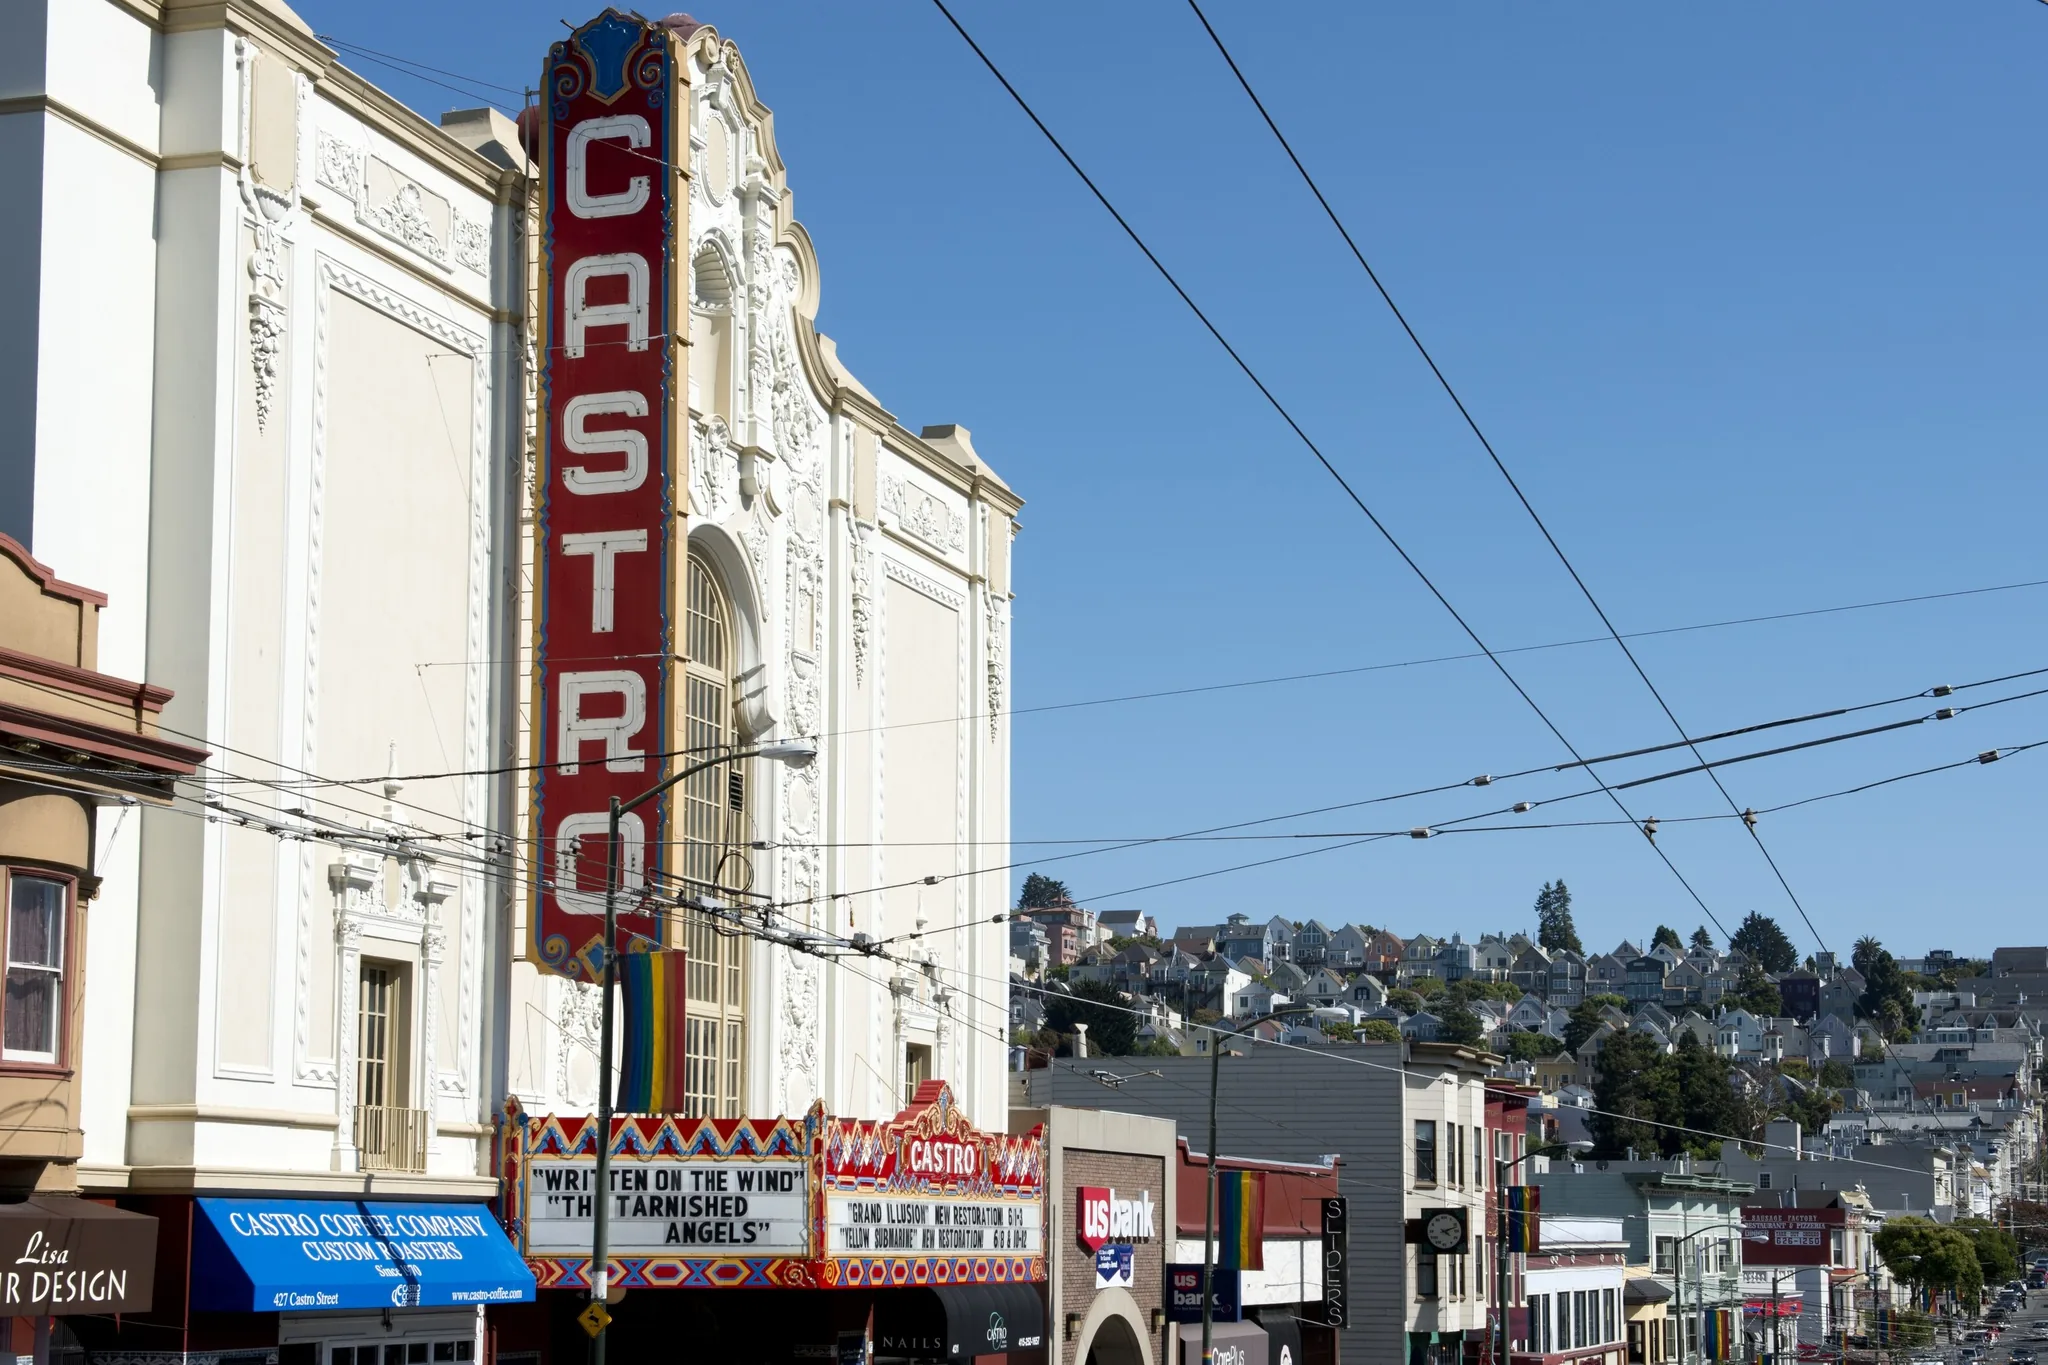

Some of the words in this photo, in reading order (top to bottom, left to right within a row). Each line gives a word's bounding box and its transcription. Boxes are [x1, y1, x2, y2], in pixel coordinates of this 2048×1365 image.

[554, 114, 651, 917] CASTRO
[911, 1140, 975, 1175] CASTRO
[655, 1169, 681, 1191] ON
[690, 1170, 728, 1191] THE
[737, 1170, 804, 1192] WIND"
[548, 1195, 596, 1217] "TH
[616, 1195, 748, 1217] TARNISHED
[848, 1202, 882, 1224] "GRAND
[886, 1203, 929, 1225] ILLUSION"
[935, 1205, 951, 1225] NEW
[954, 1206, 1003, 1226] RESTORATION!
[229, 1212, 320, 1237] CASTRO
[319, 1213, 399, 1237] COFFEE
[396, 1215, 488, 1237] COMPANY
[1751, 1214, 1782, 1222] SAUSAGE
[1787, 1214, 1818, 1222] FACTORY
[665, 1221, 770, 1244] ANGELS"
[840, 1227, 869, 1249] "YELLOW
[874, 1228, 918, 1249] SUBMARINE"
[921, 1228, 936, 1249] NEW
[938, 1229, 984, 1249] RESTORATION!
[1776, 1237, 1820, 1245] 626-1250
[15, 1230, 69, 1264] Lisa
[302, 1241, 380, 1261] CUSTOM
[376, 1241, 463, 1261] ROASTERS
[375, 1264, 402, 1278] Since
[1326, 1199, 1343, 1326] SLIDERS
[32, 1269, 127, 1303] DESIGN
[1173, 1274, 1197, 1287] us
[273, 1292, 289, 1307] 427
[289, 1292, 315, 1306] Castro
[316, 1291, 339, 1306] Street
[452, 1286, 523, 1301] www.castro-coffee.com
[883, 1336, 941, 1349] NAILS
[986, 1327, 1007, 1341] CASTRO
